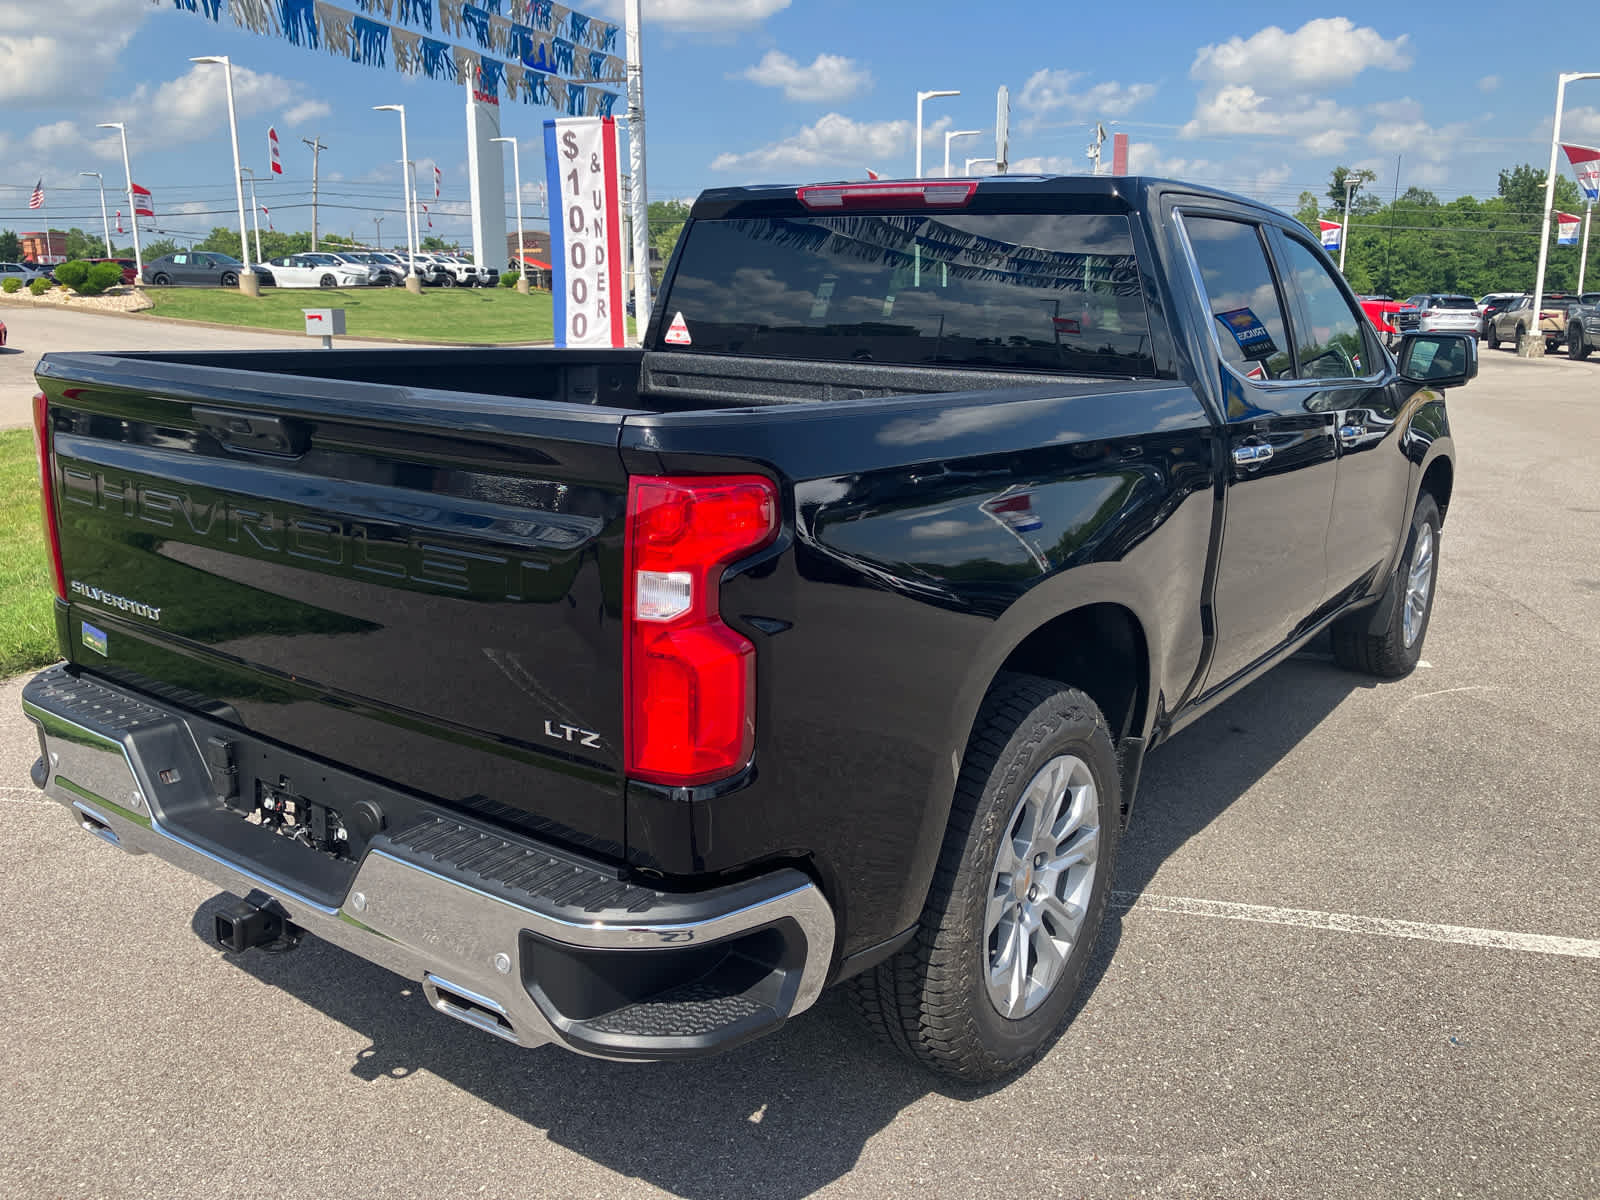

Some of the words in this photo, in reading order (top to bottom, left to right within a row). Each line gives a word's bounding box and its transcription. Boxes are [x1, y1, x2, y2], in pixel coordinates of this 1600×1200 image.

[590, 152, 601, 173] &
[562, 129, 588, 338] $10,000
[592, 190, 607, 318] UNDER
[62, 466, 551, 601] CHEVROLET
[71, 580, 161, 621] SILVERADO
[544, 720, 601, 749] LTZ
